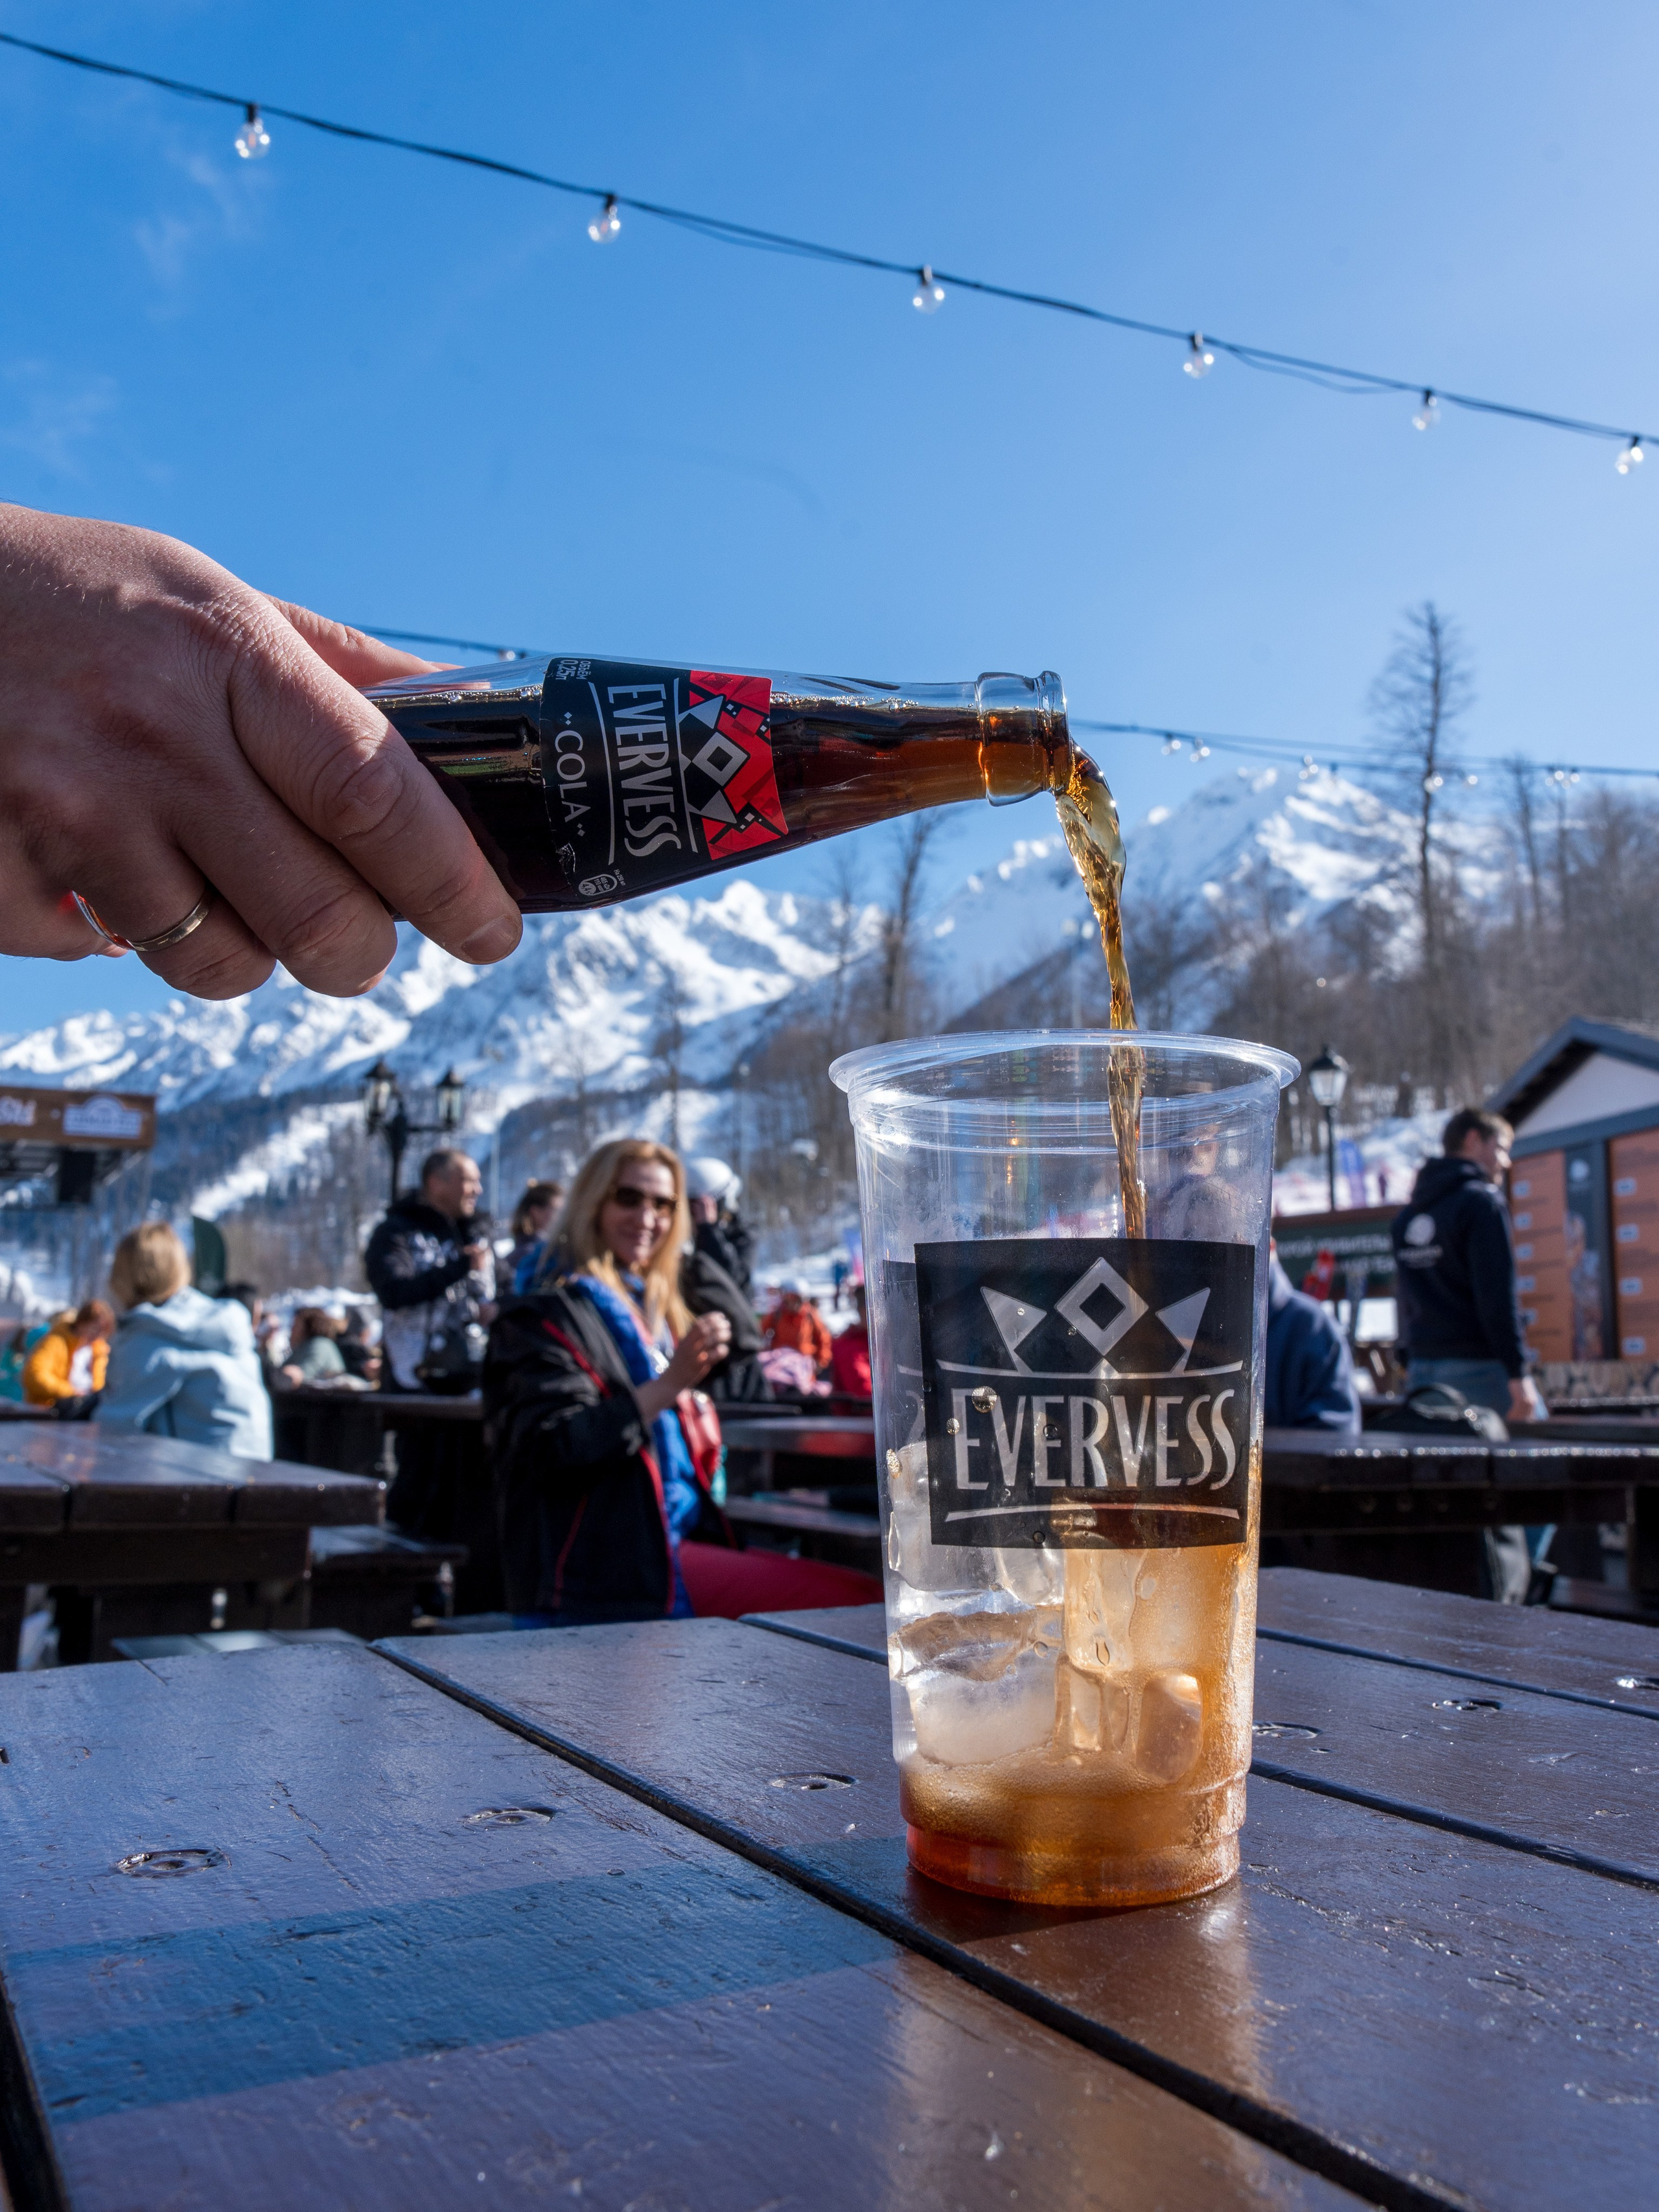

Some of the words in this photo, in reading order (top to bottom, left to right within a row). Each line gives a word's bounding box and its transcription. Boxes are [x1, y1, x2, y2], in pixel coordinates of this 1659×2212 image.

[576, 660, 591, 680] ОБЪЁМ
[555, 730, 591, 822] COLA
[607, 684, 681, 857] EVERVESS
[951, 1388, 1235, 1490] EVERVESS
